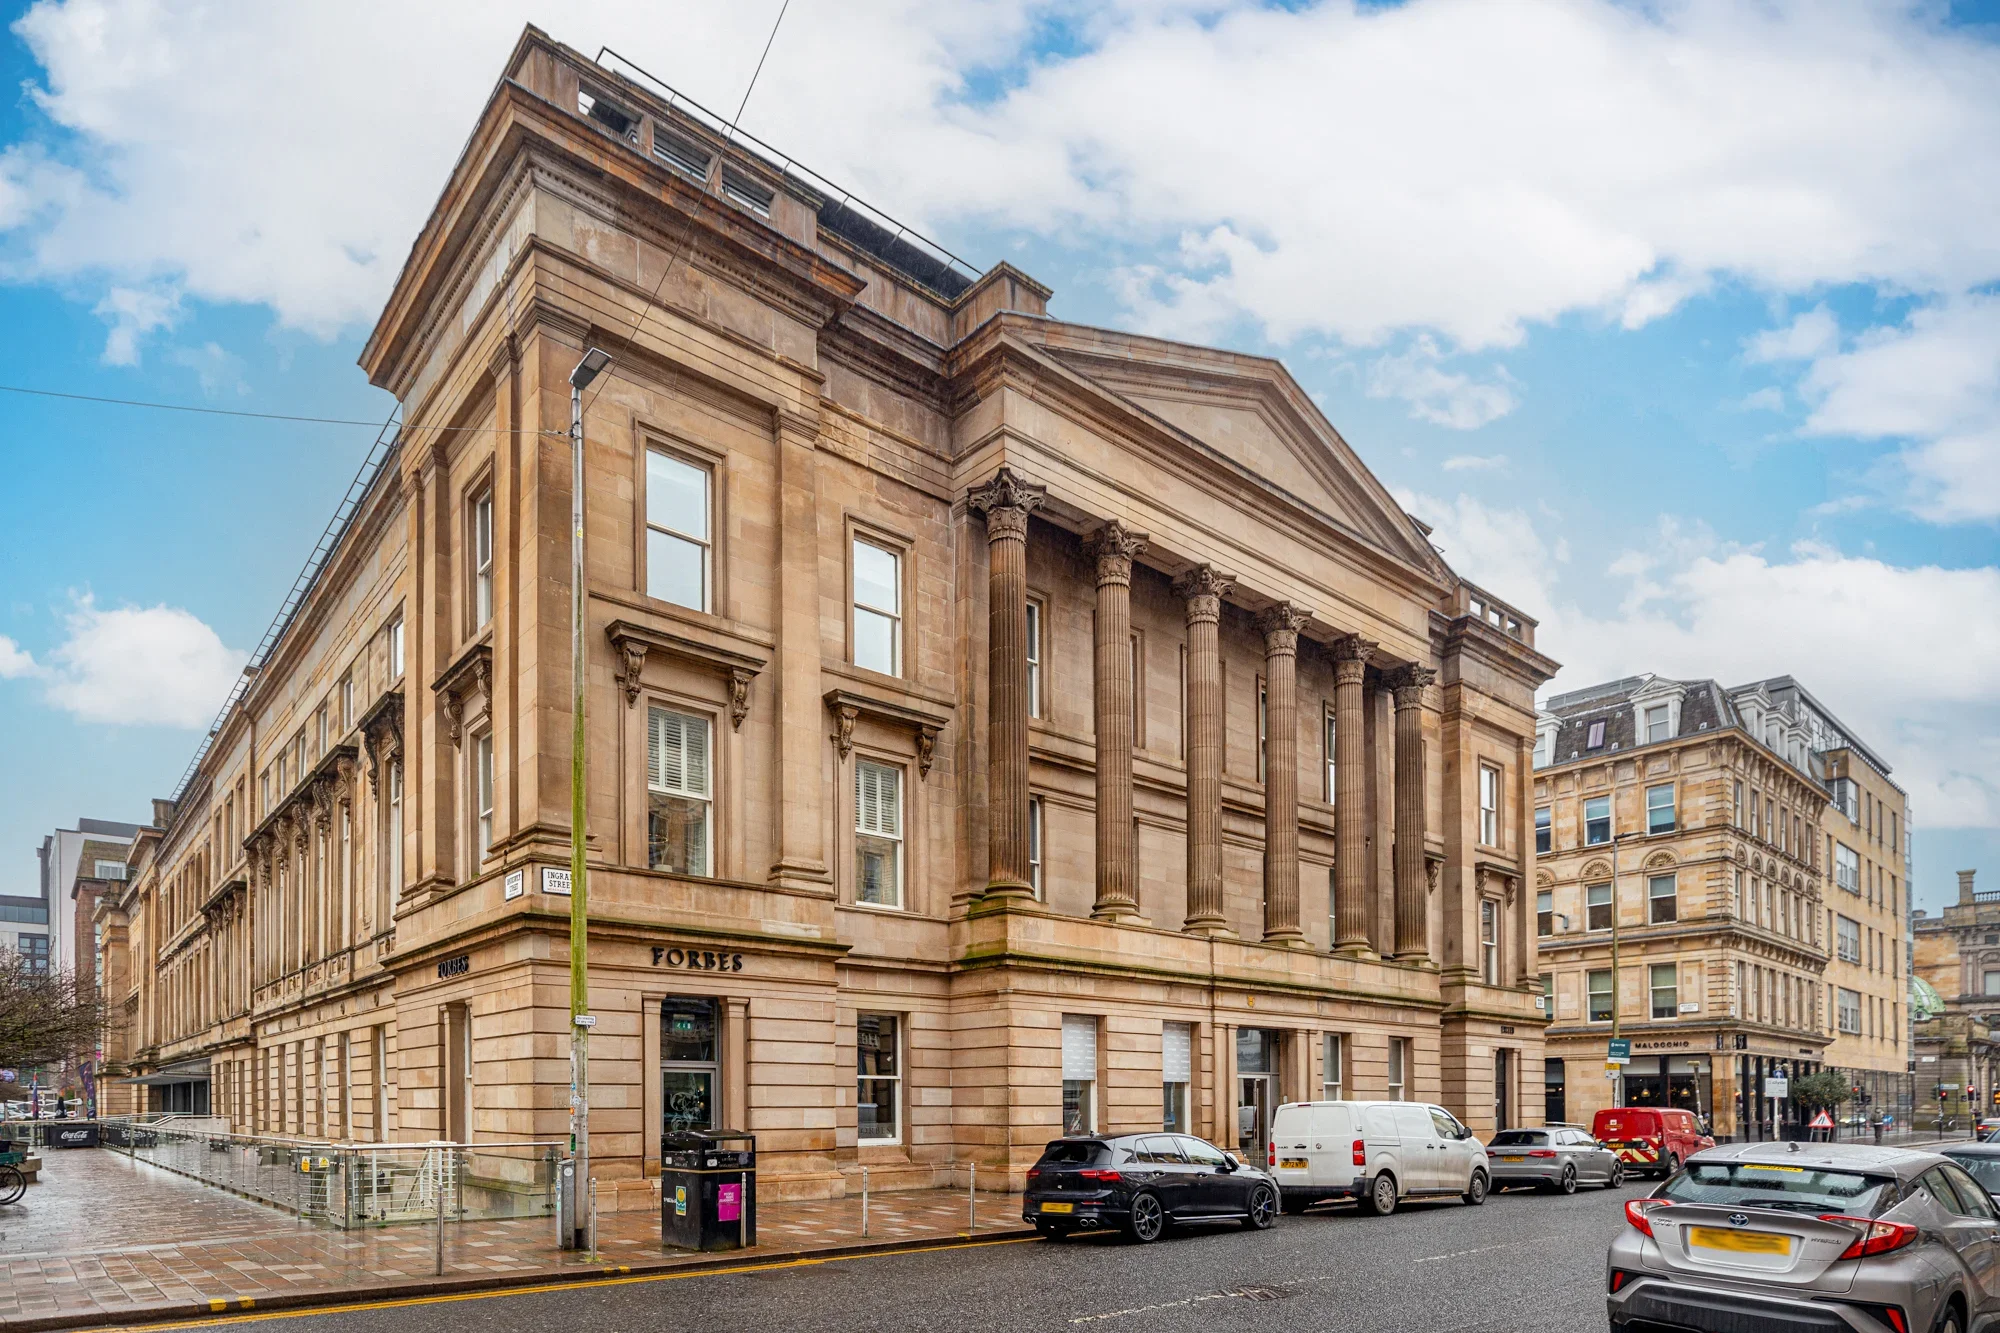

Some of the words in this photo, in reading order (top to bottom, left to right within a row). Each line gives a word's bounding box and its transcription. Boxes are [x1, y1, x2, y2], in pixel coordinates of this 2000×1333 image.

[438, 955, 469, 978] FORBES
[651, 946, 743, 972] FORBES
[1635, 1041, 1689, 1049] MALOCCHIO
[860, 1125, 892, 1135] ORBES
